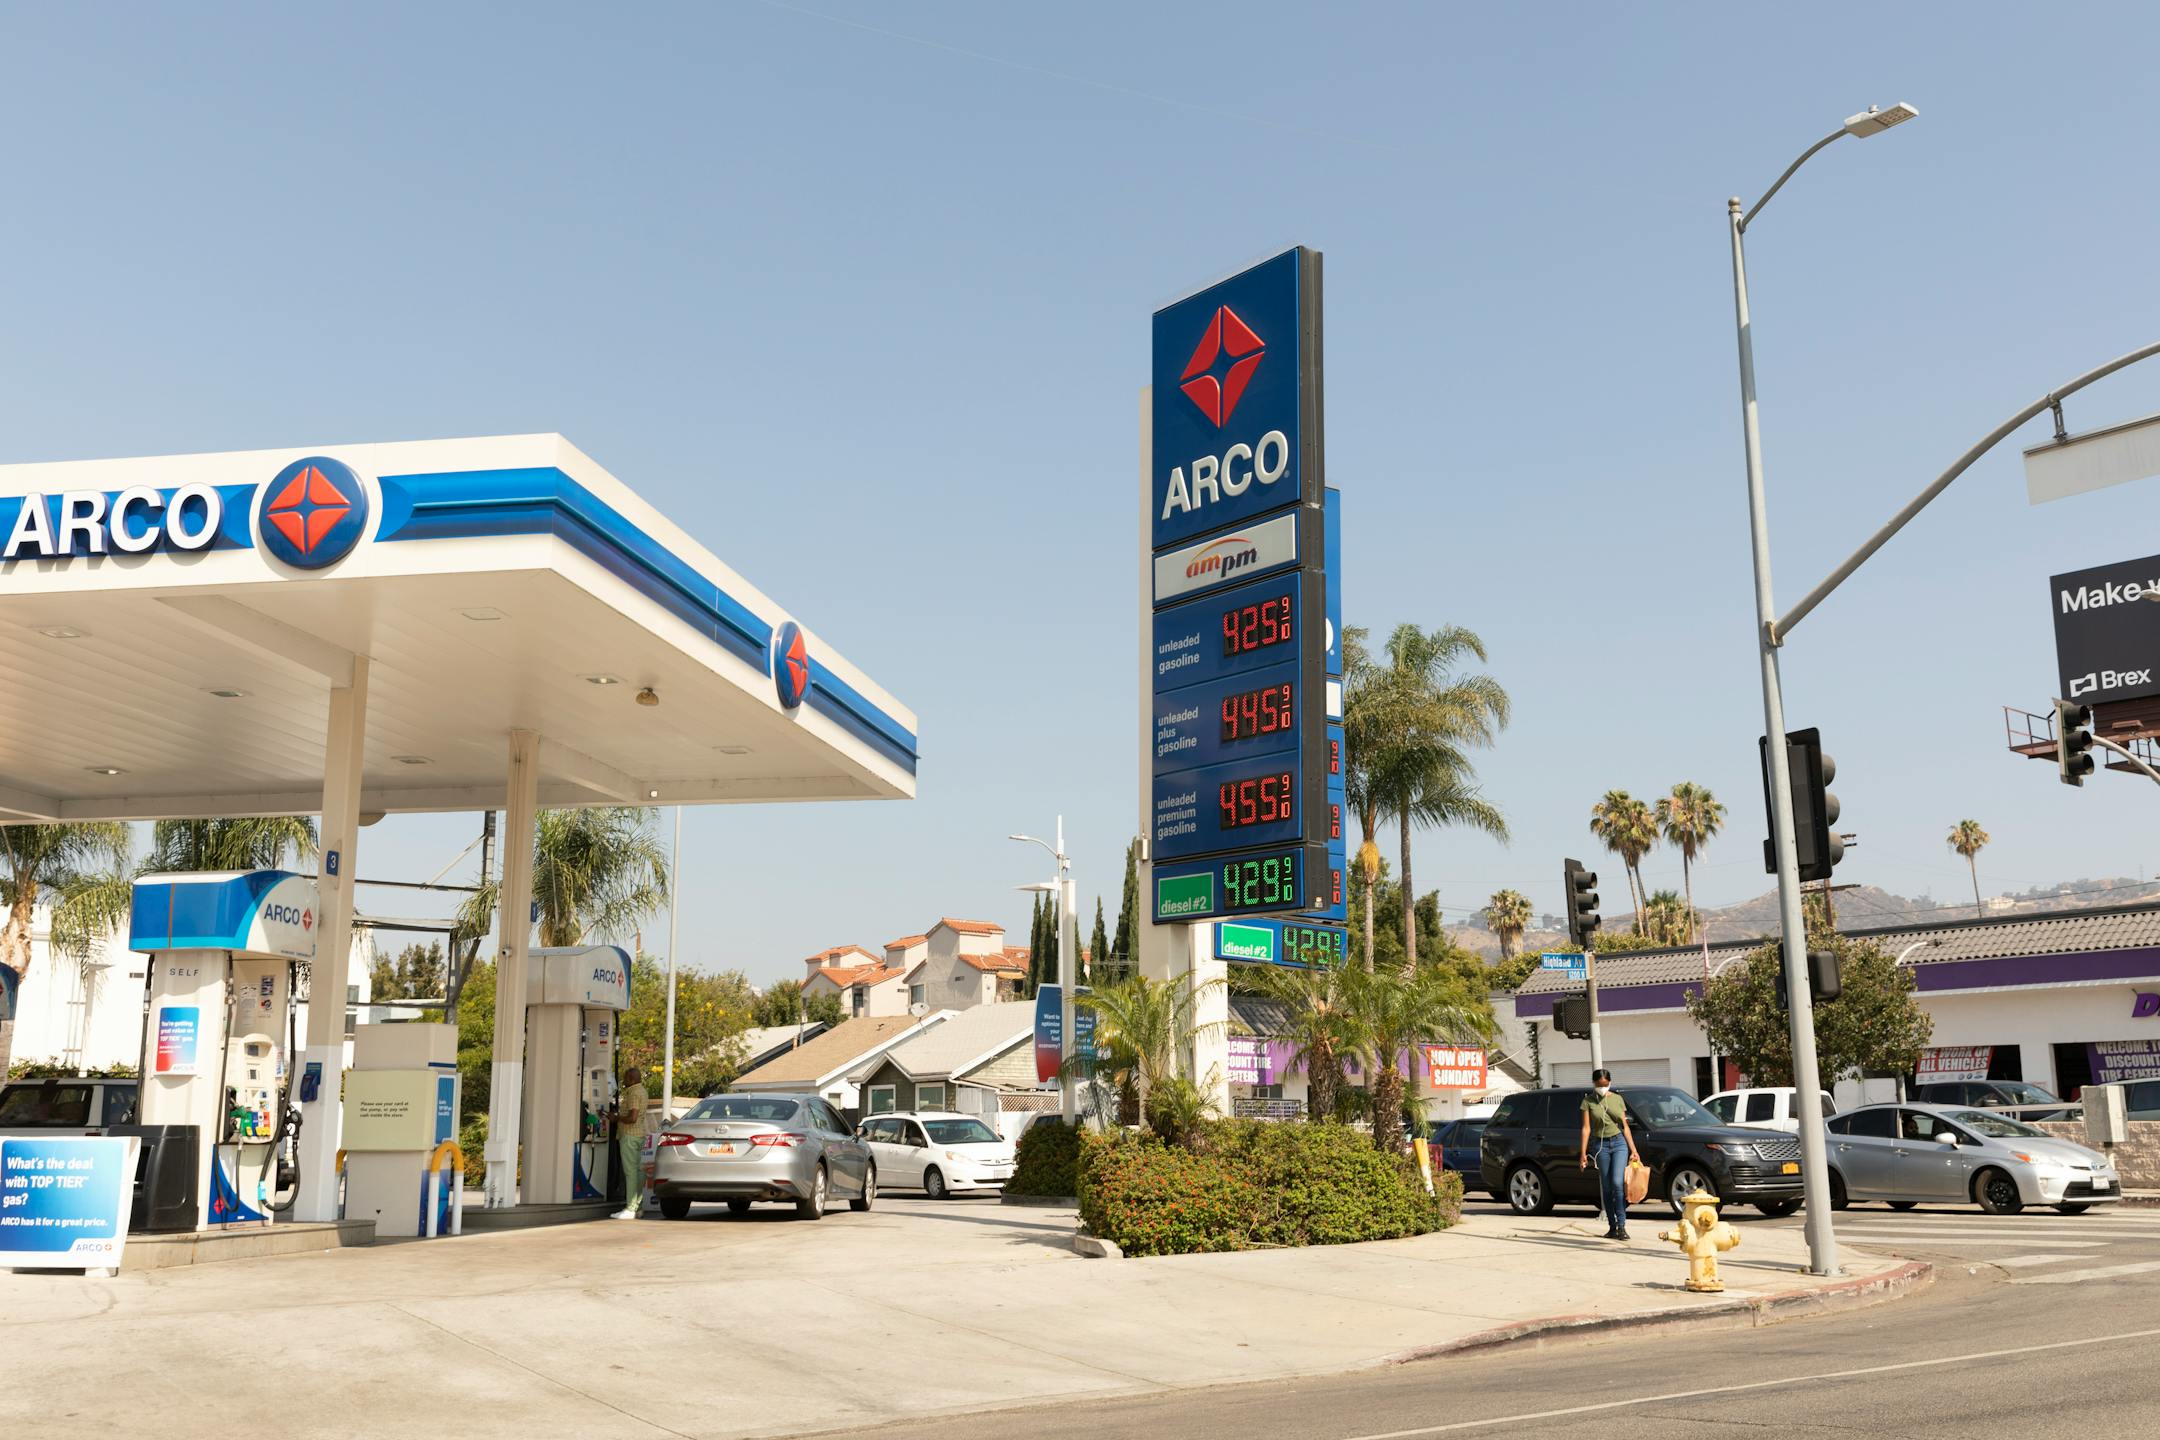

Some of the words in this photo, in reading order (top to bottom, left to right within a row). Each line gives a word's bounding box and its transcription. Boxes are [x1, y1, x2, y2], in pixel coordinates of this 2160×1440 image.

[1162, 430, 1289, 521] ARCO
[3, 482, 222, 557] ARCO
[1186, 547, 1257, 578] ampm
[2061, 582, 2141, 614] Make
[1223, 600, 1277, 653] 425
[1159, 632, 1200, 654] unleaded
[1159, 653, 1200, 675] gasoline
[2101, 668, 2152, 690] Brex
[1158, 706, 1198, 727] unleaded
[1222, 688, 1277, 739] 445
[1158, 726, 1176, 742] plus
[1158, 735, 1197, 757] gasoline
[1158, 791, 1196, 810] unleaded
[1219, 776, 1277, 827] 455
[1157, 807, 1196, 826] premium
[1158, 821, 1197, 841] gasoline
[330, 855, 337, 869] 3
[264, 903, 300, 925] ARCO
[1543, 955, 1571, 969] Highland
[169, 967, 200, 976] SELF
[593, 968, 617, 984] ARCO
[2096, 1040, 2150, 1055] WELCOME
[1253, 1056, 1272, 1069] TIRE
[1431, 1050, 1456, 1066] NOW
[1457, 1051, 1483, 1067] OPEN
[1920, 1058, 1937, 1072] ALL
[1938, 1057, 1988, 1071] VEHICLES
[2104, 1053, 2160, 1069] DISCOUNT
[1434, 1069, 1480, 1086] SUNDAYS
[2098, 1069, 2123, 1082] TIRE
[7, 1157, 44, 1170] What's
[46, 1157, 65, 1170] the
[67, 1157, 94, 1170] deal
[5, 1175, 28, 1188] with
[30, 1176, 54, 1188] TOP
[3, 1193, 29, 1208] gas?
[1, 1216, 21, 1226] ARCO
[21, 1217, 35, 1226] has
[35, 1217, 42, 1226] it
[42, 1217, 54, 1226] for
[61, 1218, 84, 1228] great
[84, 1217, 108, 1228] price.
[76, 1243, 103, 1252] ARCO
